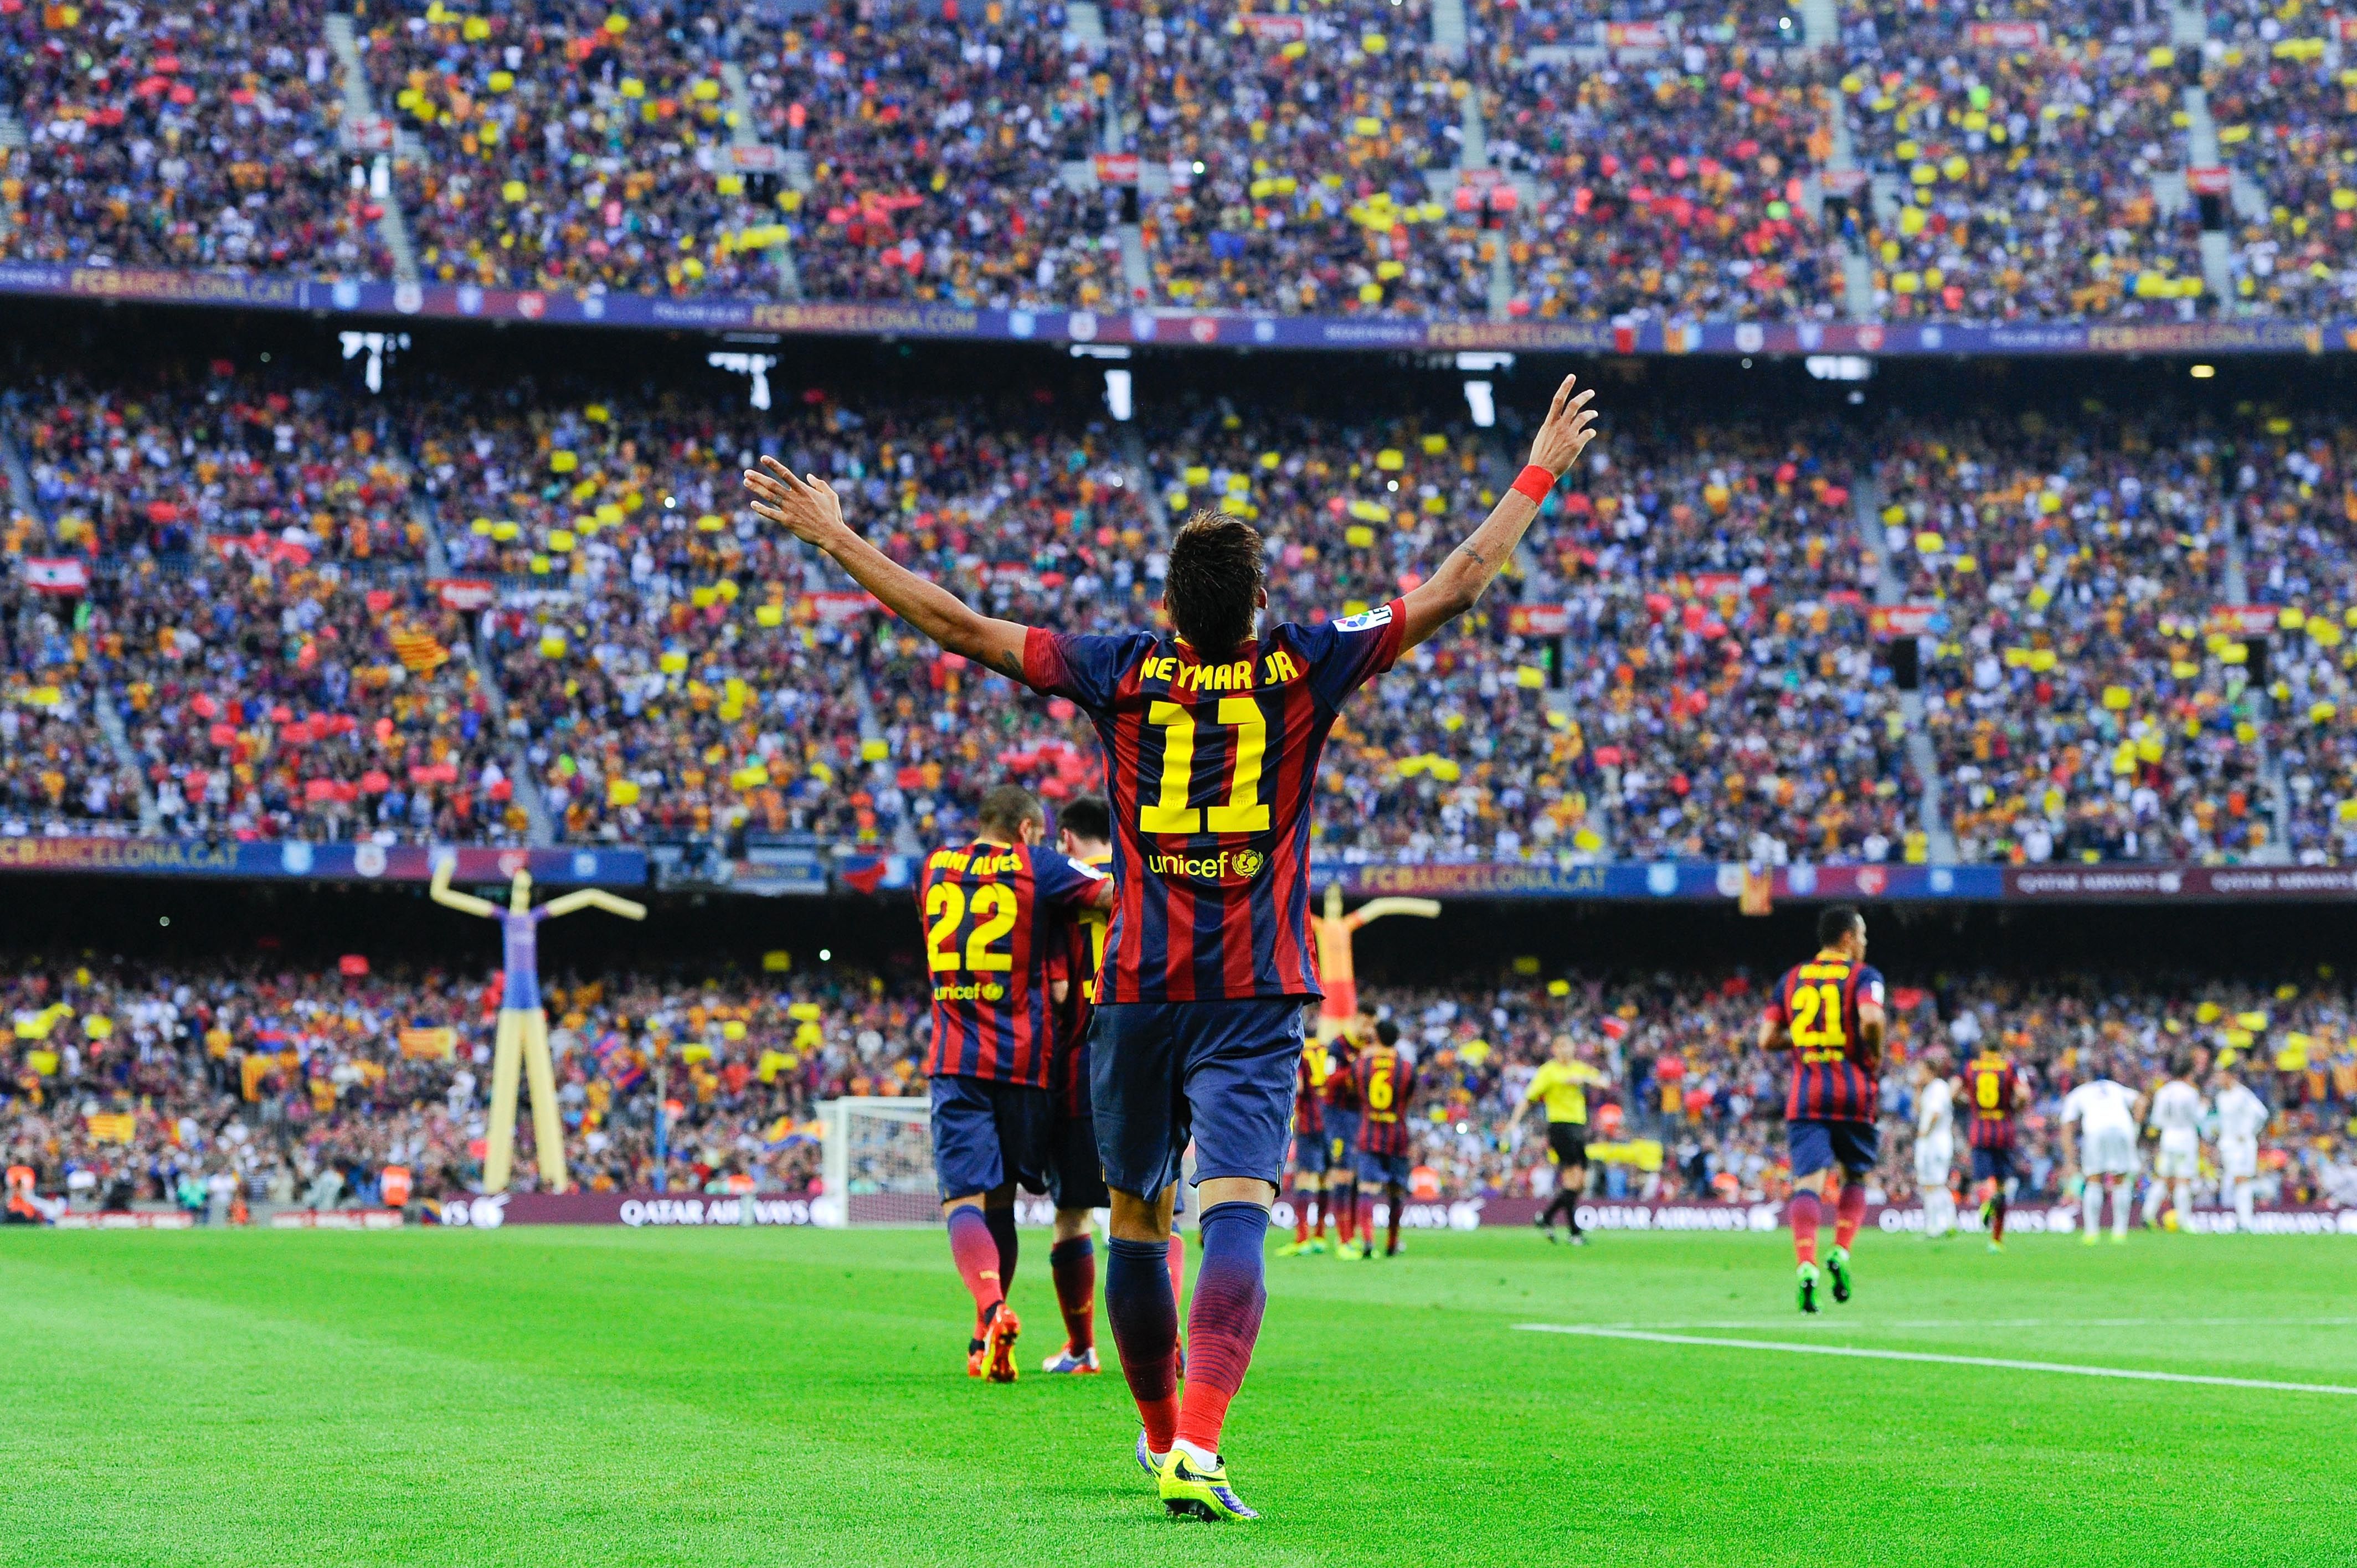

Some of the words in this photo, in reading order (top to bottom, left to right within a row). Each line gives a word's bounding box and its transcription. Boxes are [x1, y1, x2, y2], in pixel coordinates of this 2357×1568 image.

[752, 303, 977, 331] FCBARCELONA.COM
[1140, 657, 1252, 692] NEYMAR
[1265, 650, 1299, 685] JR
[1140, 697, 1270, 833] 11
[971, 852, 1023, 876] ALVES
[1149, 853, 1228, 878] unicef
[925, 882, 1018, 973] 22
[934, 982, 982, 1001] unicef
[1789, 984, 1847, 1048] 21
[1369, 1069, 1393, 1110] 6
[620, 1199, 704, 1227] QATAR
[1574, 1205, 1651, 1231] QATAR
[1652, 1206, 1747, 1230] AIRWAYS
